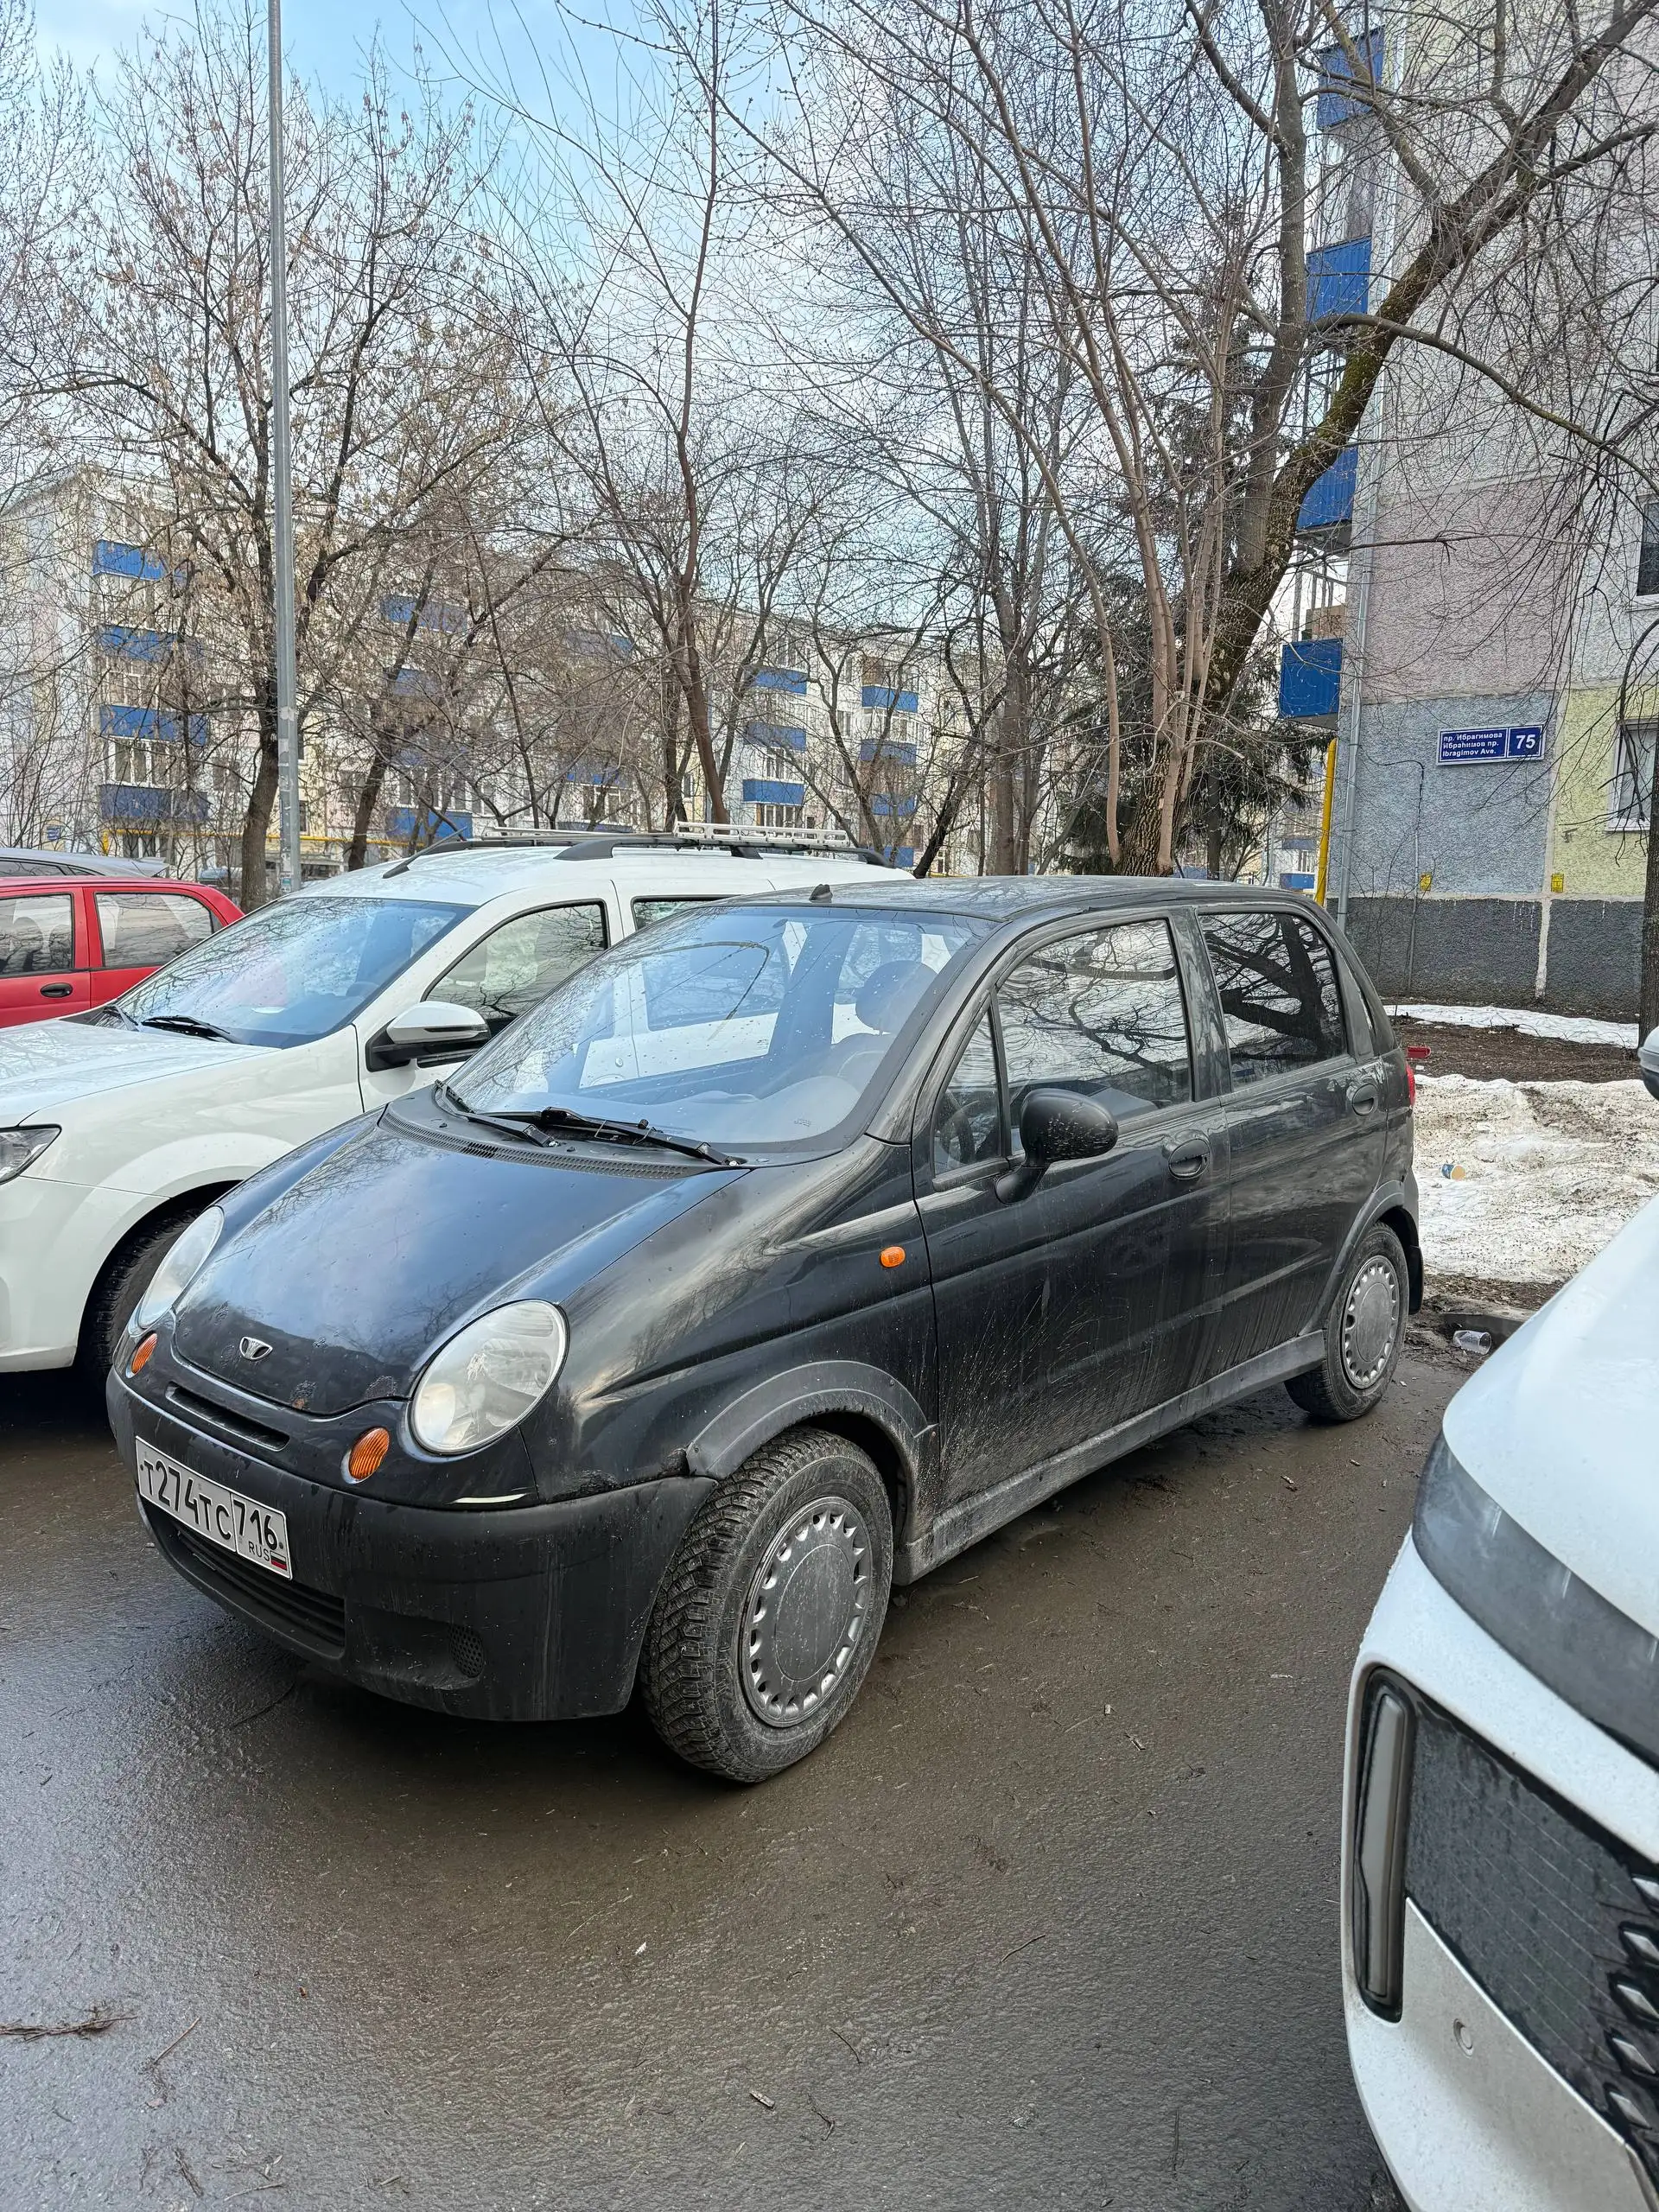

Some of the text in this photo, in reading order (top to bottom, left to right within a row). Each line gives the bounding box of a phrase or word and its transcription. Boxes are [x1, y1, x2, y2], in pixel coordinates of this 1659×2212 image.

[1457, 733, 1503, 741] Ибрагимова
[1516, 734, 1535, 749] 75
[248, 1541, 270, 1562] RUS
